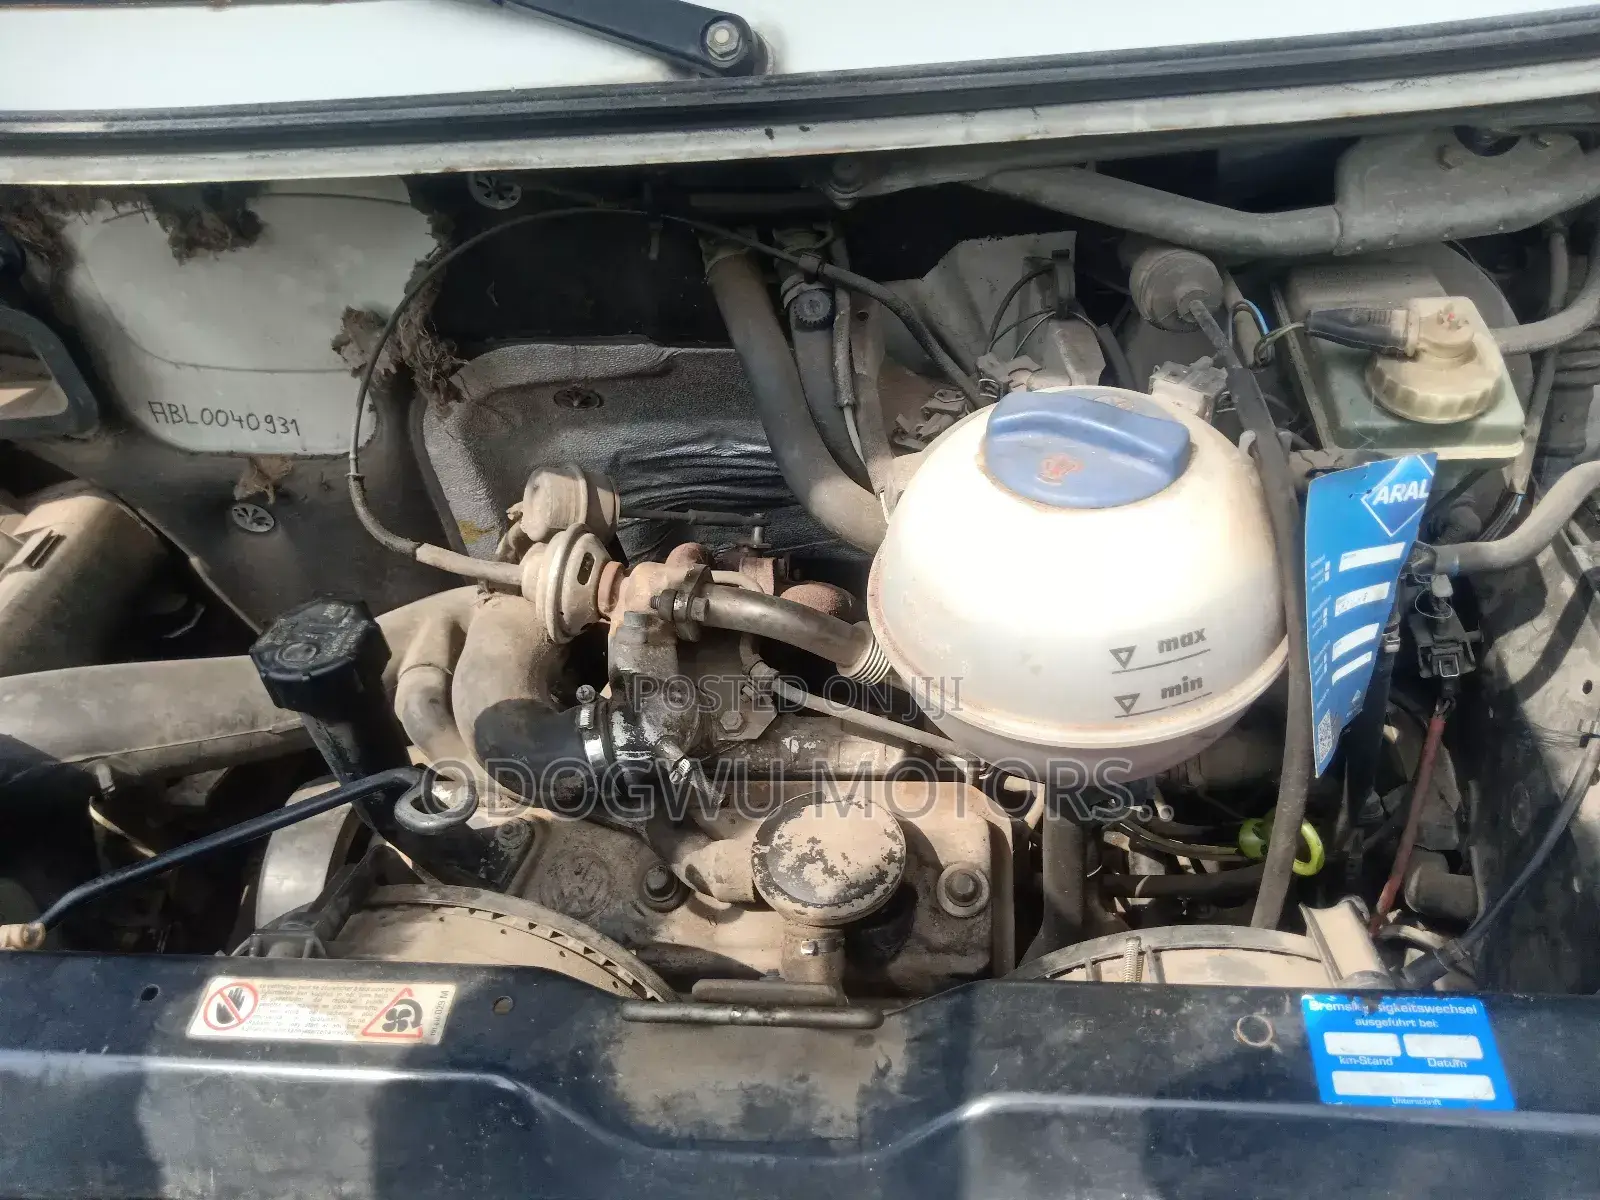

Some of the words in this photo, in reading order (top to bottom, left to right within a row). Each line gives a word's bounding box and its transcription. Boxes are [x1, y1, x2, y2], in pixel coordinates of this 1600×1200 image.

[1372, 478, 1429, 506] ARAL
[1157, 628, 1207, 654] max
[1160, 675, 1203, 700] min
[1339, 1056, 1394, 1067] km-Stand
